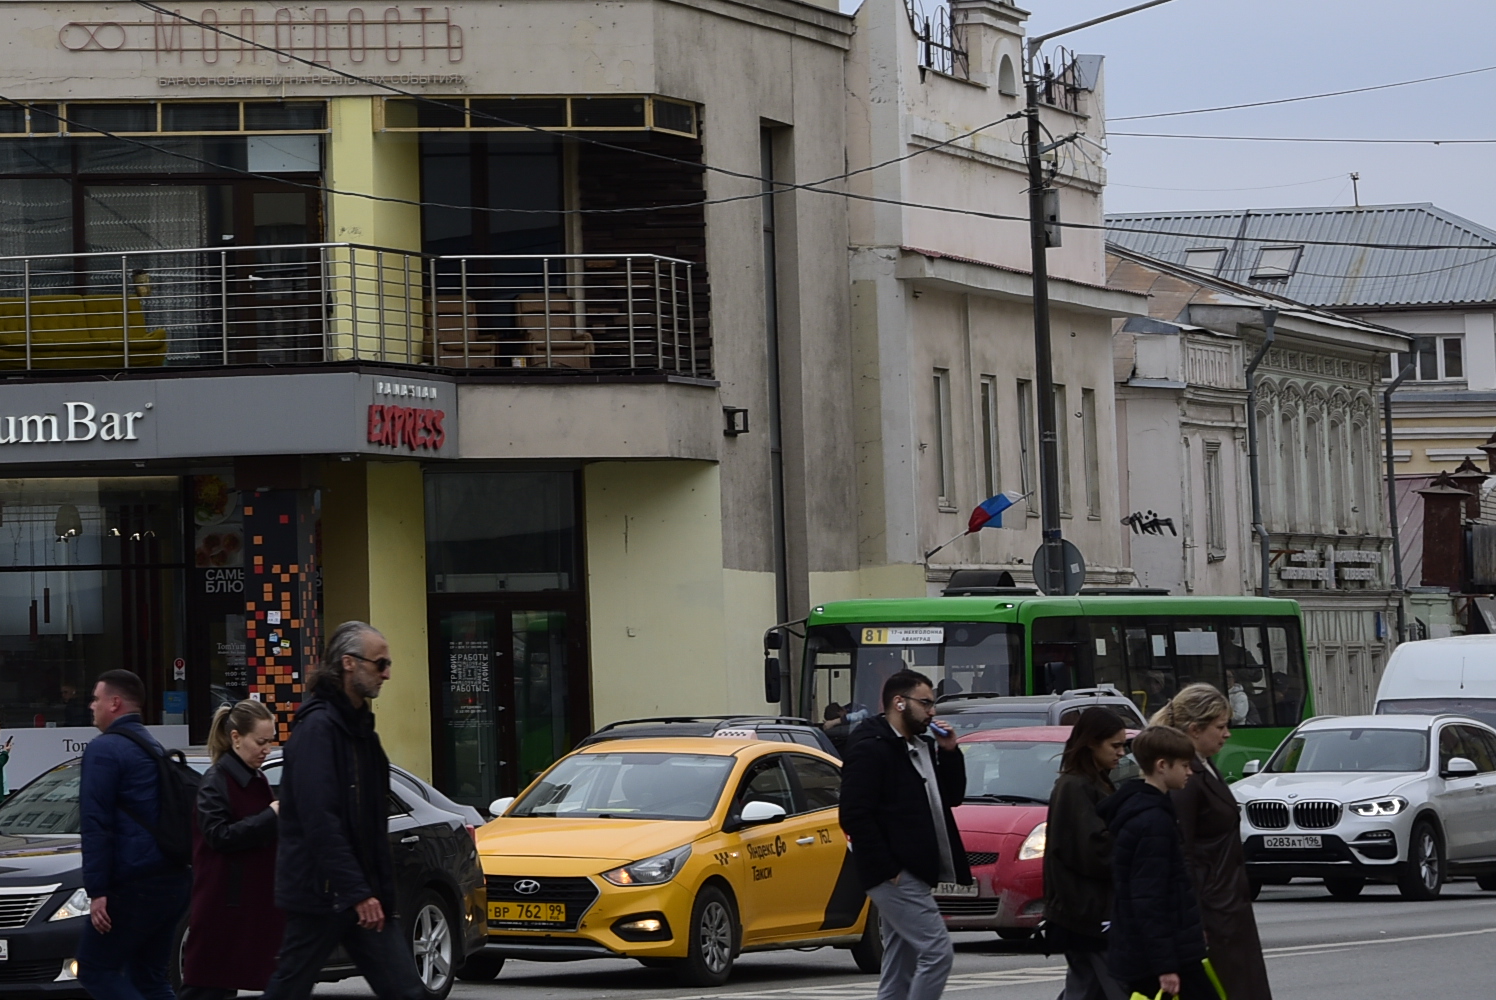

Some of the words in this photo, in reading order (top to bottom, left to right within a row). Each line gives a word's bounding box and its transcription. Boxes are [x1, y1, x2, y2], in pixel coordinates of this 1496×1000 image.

[155, 8, 463, 69] МОЛОДОСТЬ
[187, 74, 284, 87] ОСНОВАННЫЙ
[289, 75, 308, 86] НА
[312, 74, 386, 86] РЕАЛЬНЫХ
[389, 74, 466, 85] СОБЫТИЯХ
[367, 405, 446, 451] EXPRESS
[865, 630, 882, 641] 81
[817, 828, 832, 845] 762
[1304, 836, 1319, 845] 196
[747, 843, 775, 860] Яндекс
[775, 835, 787, 857] Go
[752, 865, 772, 881] Такси
[517, 904, 541, 919] 762
[548, 904, 562, 915] 99
